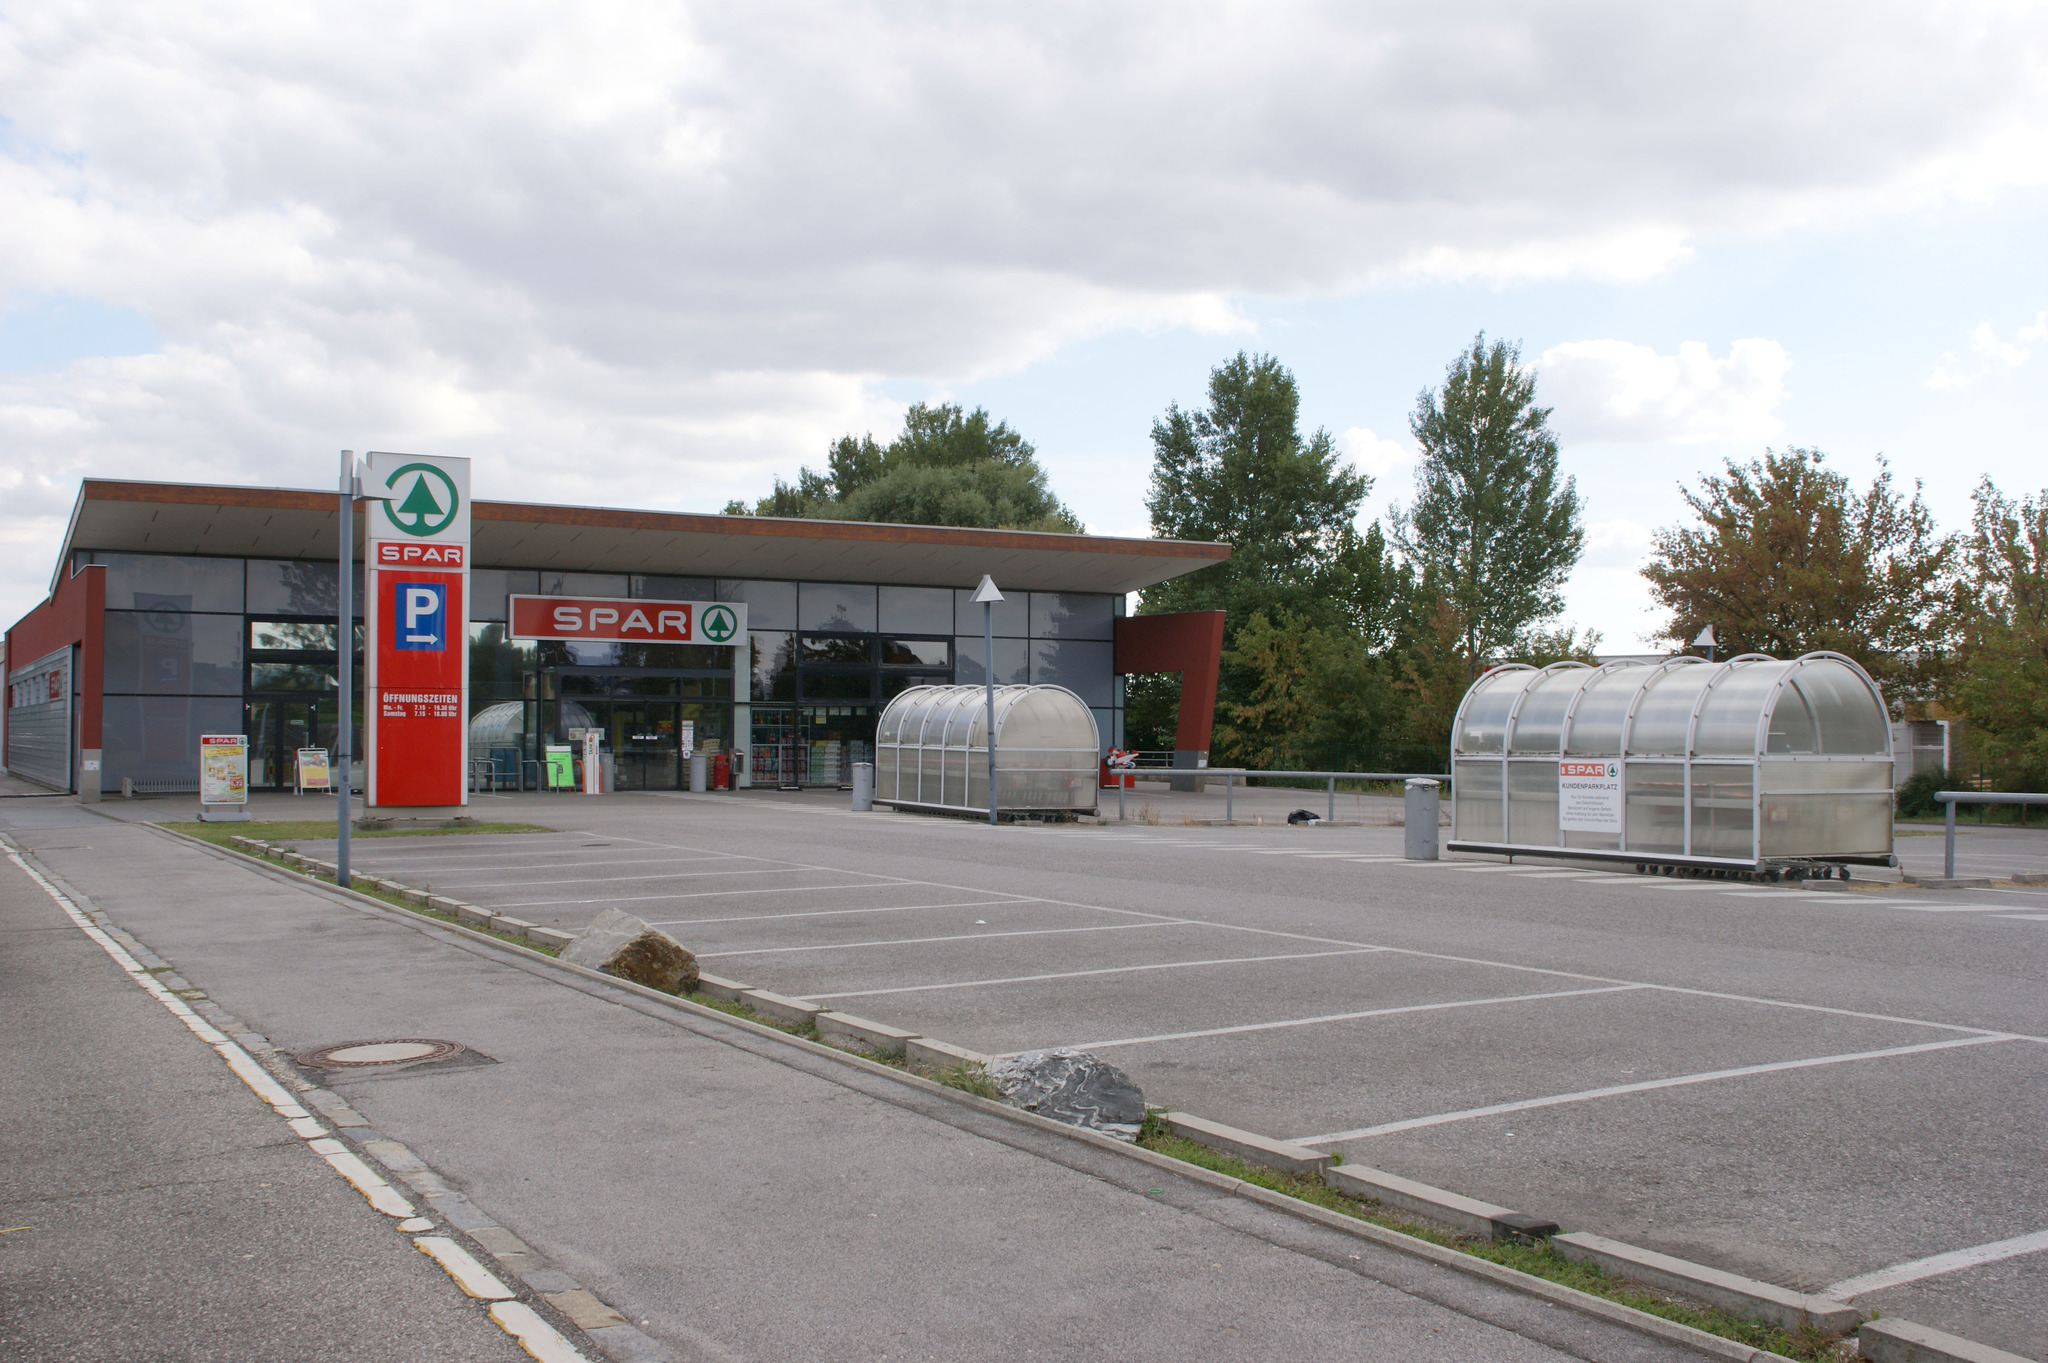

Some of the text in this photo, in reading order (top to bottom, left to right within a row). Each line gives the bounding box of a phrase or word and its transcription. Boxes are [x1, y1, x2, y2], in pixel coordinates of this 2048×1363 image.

[382, 547, 461, 563] SPAR
[406, 588, 438, 628] P
[554, 606, 687, 634] SPAR
[383, 692, 457, 703] ÖFFNUNGSZEITEN
[1568, 766, 1603, 774] SPAR
